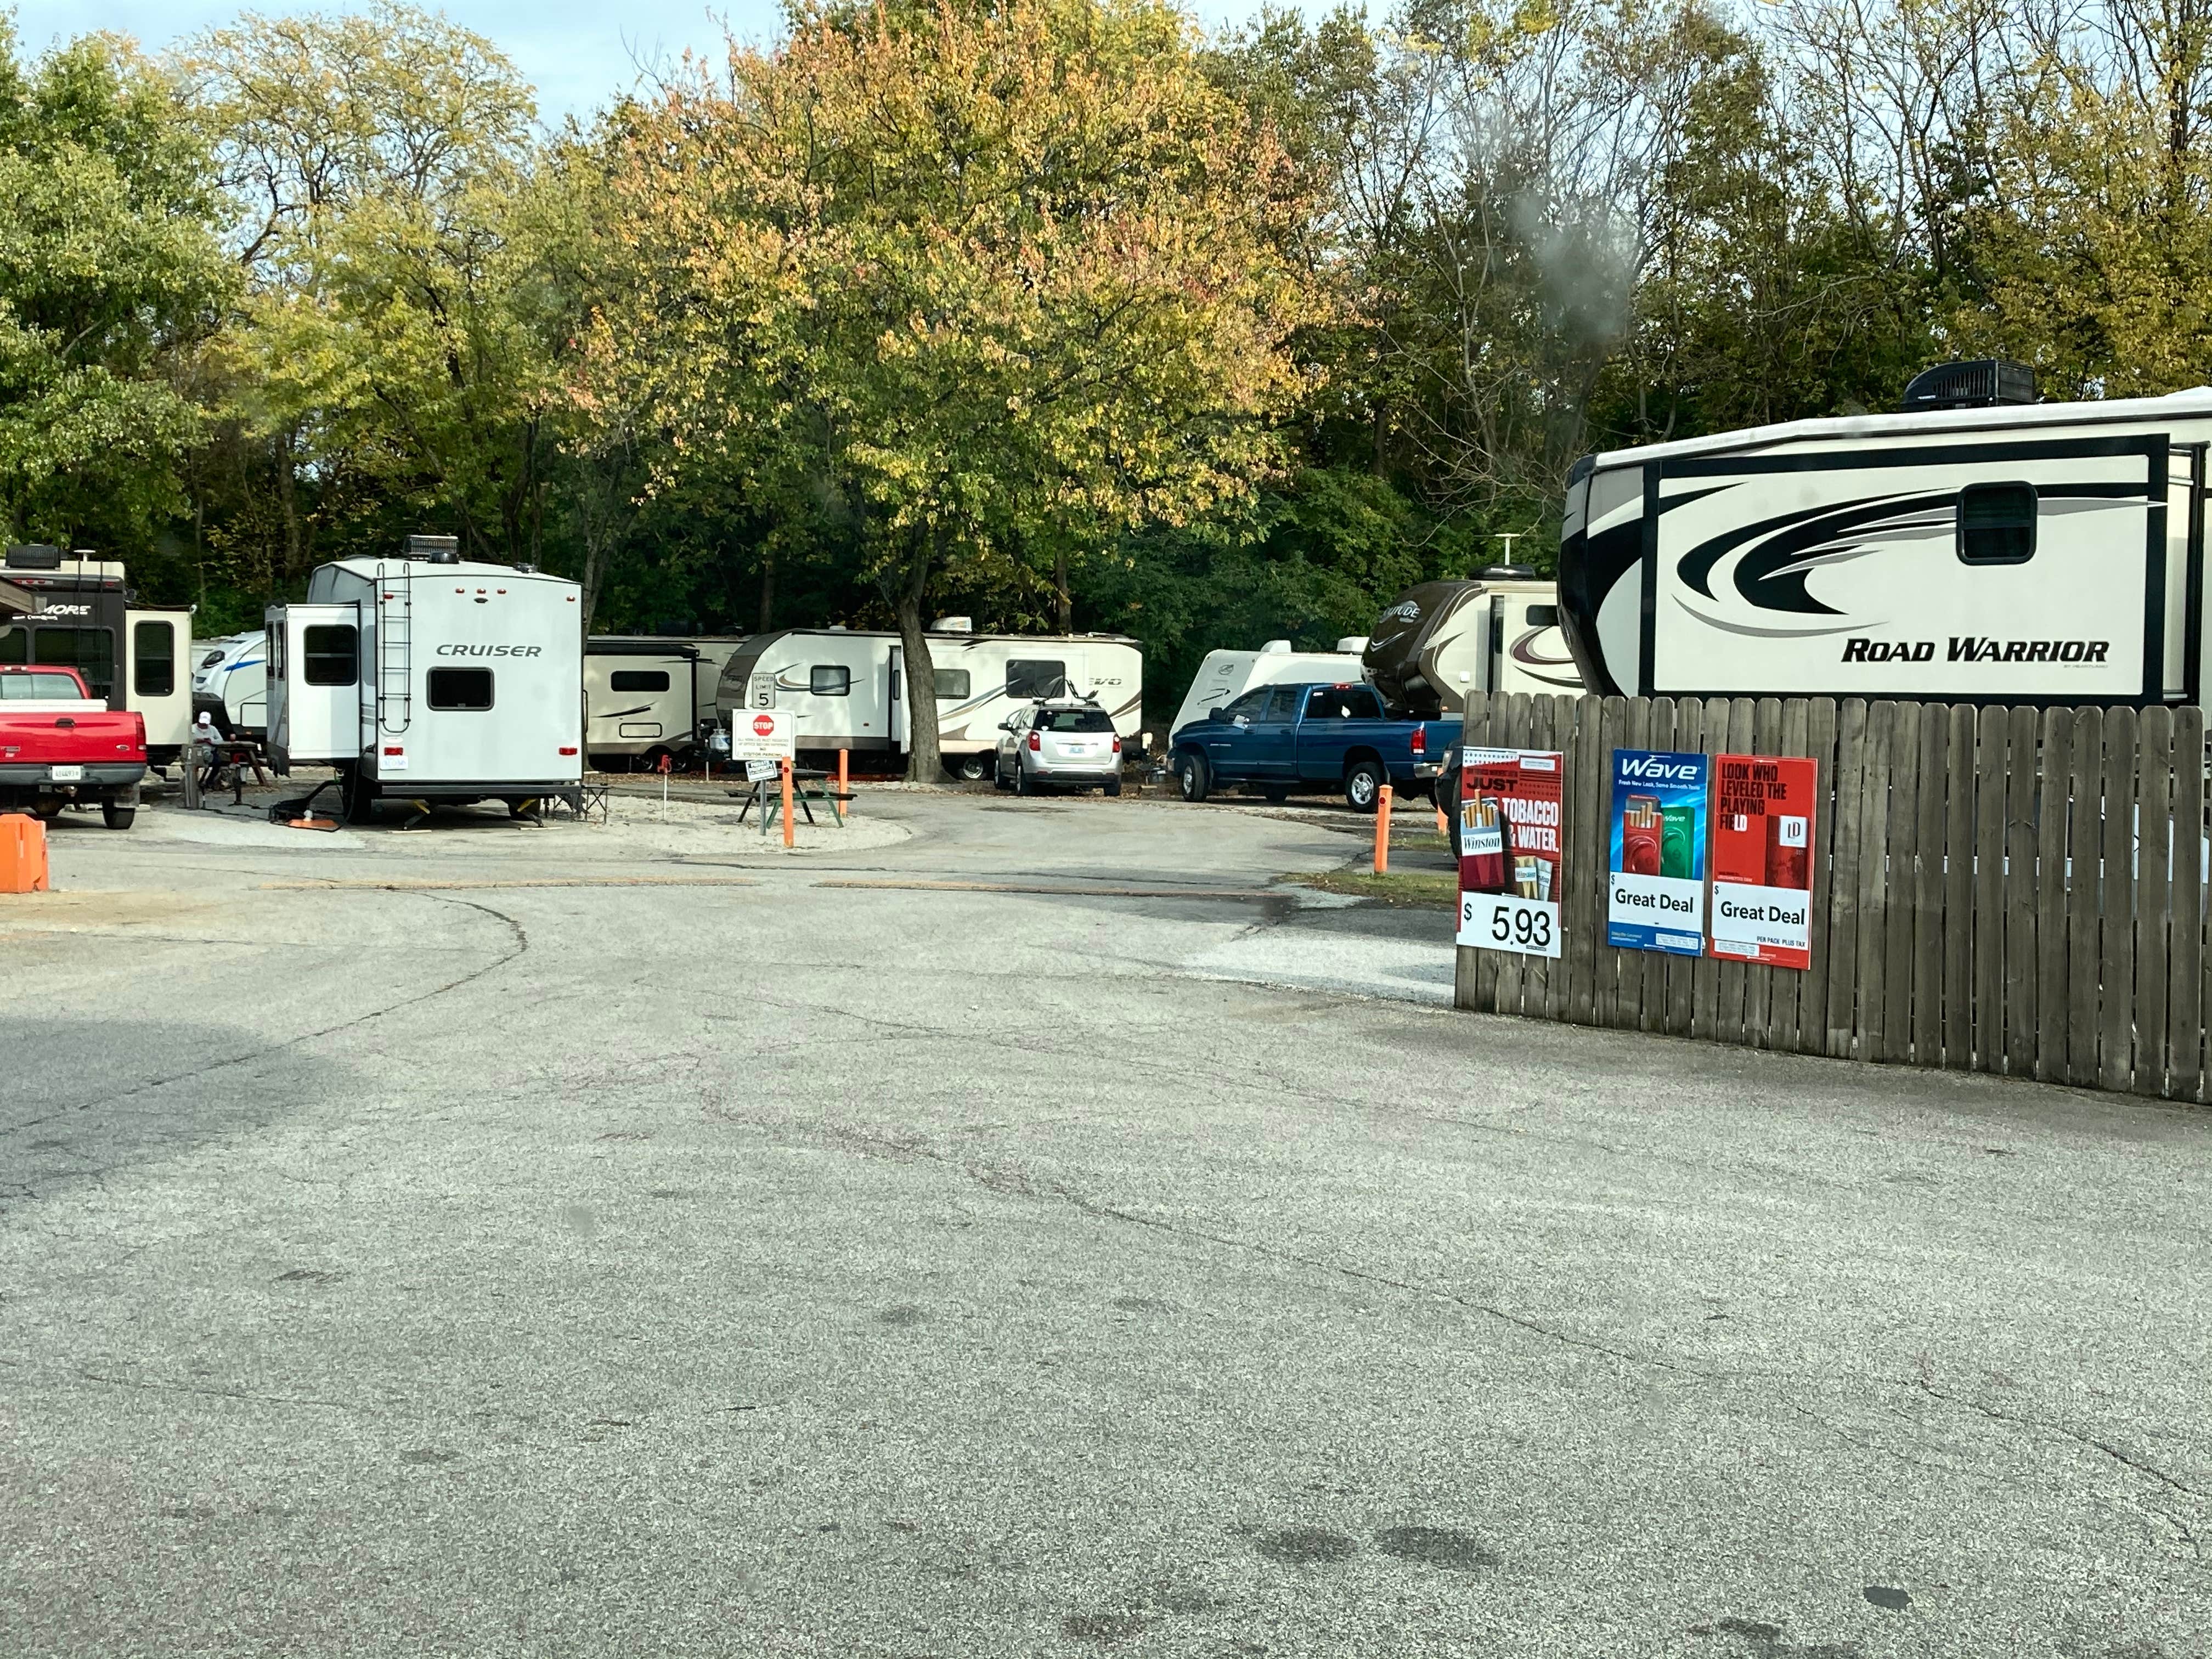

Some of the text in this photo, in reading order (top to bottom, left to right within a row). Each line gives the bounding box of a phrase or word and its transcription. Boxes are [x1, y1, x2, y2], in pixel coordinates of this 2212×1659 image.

[436, 644, 542, 657] CRUISER
[1841, 636, 2110, 663] ROAD WARRIOR
[759, 693, 769, 706] 5
[1622, 758, 1698, 780] Wave
[1722, 763, 1778, 782] LOOK WHO
[1466, 776, 1518, 792] JUST
[1721, 780, 1787, 800] LEVELED THE
[1502, 797, 1559, 827] TOBACCO
[1720, 797, 1765, 816] PLAYING
[1719, 814, 1748, 832] FIELD
[1464, 837, 1500, 850] Winston
[1517, 825, 1559, 853] WATER.
[1611, 874, 1615, 885] $
[1714, 885, 1719, 895] $
[1615, 888, 1694, 913] Great Deal
[1721, 901, 1805, 925] Great Deal
[1464, 901, 1550, 946] $ 5.93
